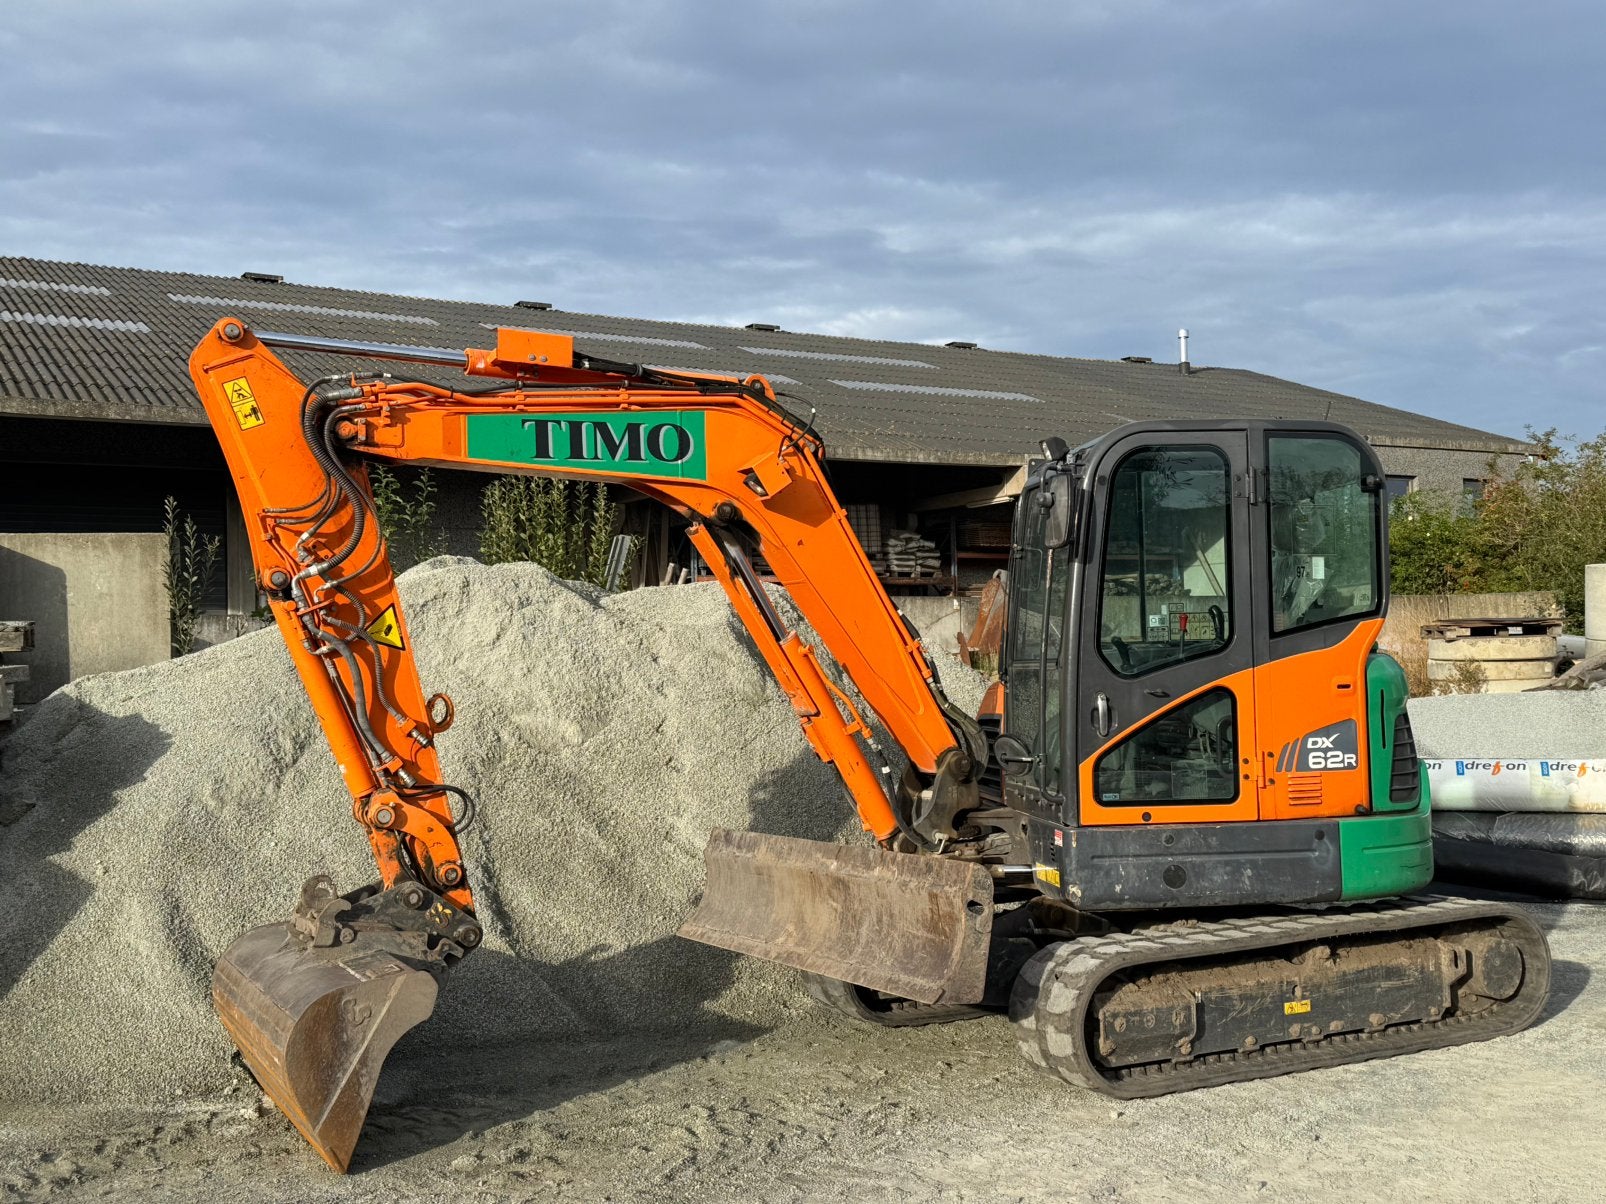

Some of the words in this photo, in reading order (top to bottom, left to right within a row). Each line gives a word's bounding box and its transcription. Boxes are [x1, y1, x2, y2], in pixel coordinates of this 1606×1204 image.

[521, 418, 694, 464] TIMO
[1306, 733, 1339, 749] DX
[1308, 750, 1357, 769] 62R
